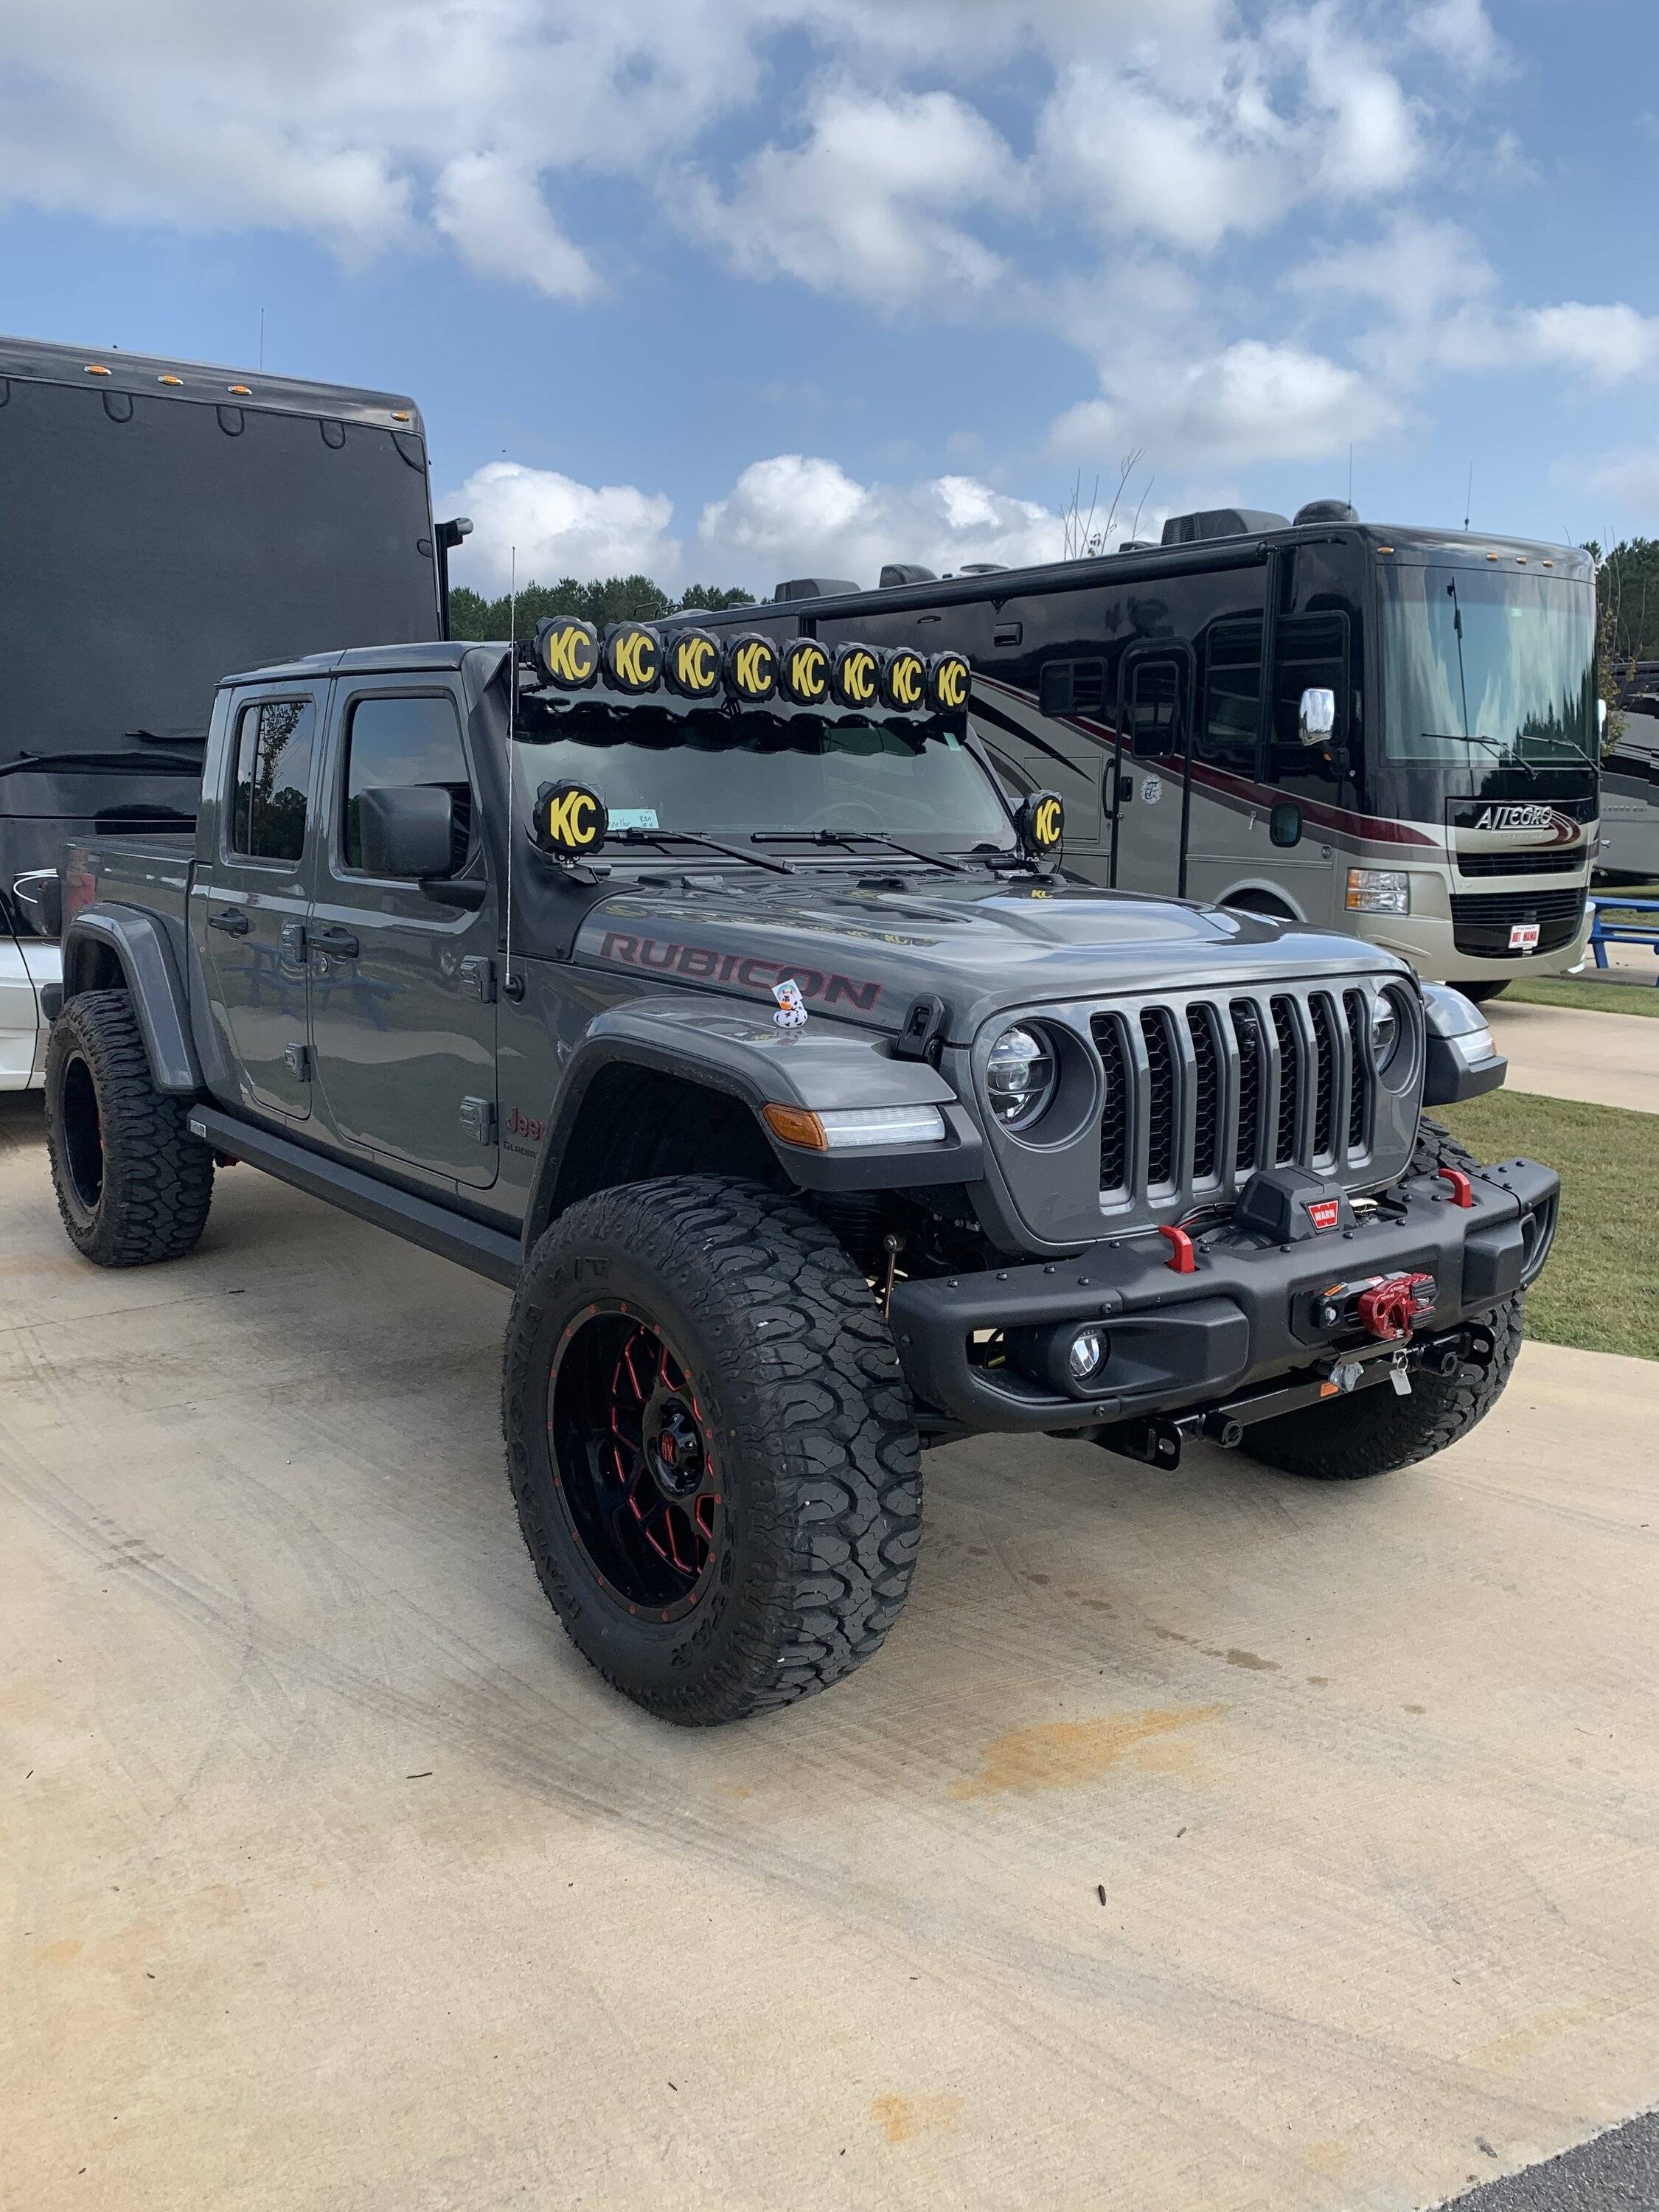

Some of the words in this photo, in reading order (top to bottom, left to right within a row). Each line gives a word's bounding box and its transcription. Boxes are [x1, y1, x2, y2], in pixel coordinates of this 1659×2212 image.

[550, 627, 591, 680] KC
[616, 633, 654, 684] KC
[678, 638, 714, 689] KC
[737, 642, 771, 693] KC
[792, 648, 824, 696] KC
[844, 653, 874, 699] KC
[892, 656, 921, 703] KC
[938, 661, 966, 706] KC
[550, 790, 596, 846] KC
[1037, 800, 1060, 844] KC
[1475, 806, 1552, 833] ALLEGRO
[600, 932, 883, 1012] RUBICON
[507, 1107, 545, 1141] Jee
[1314, 1209, 1335, 1222] WARN
